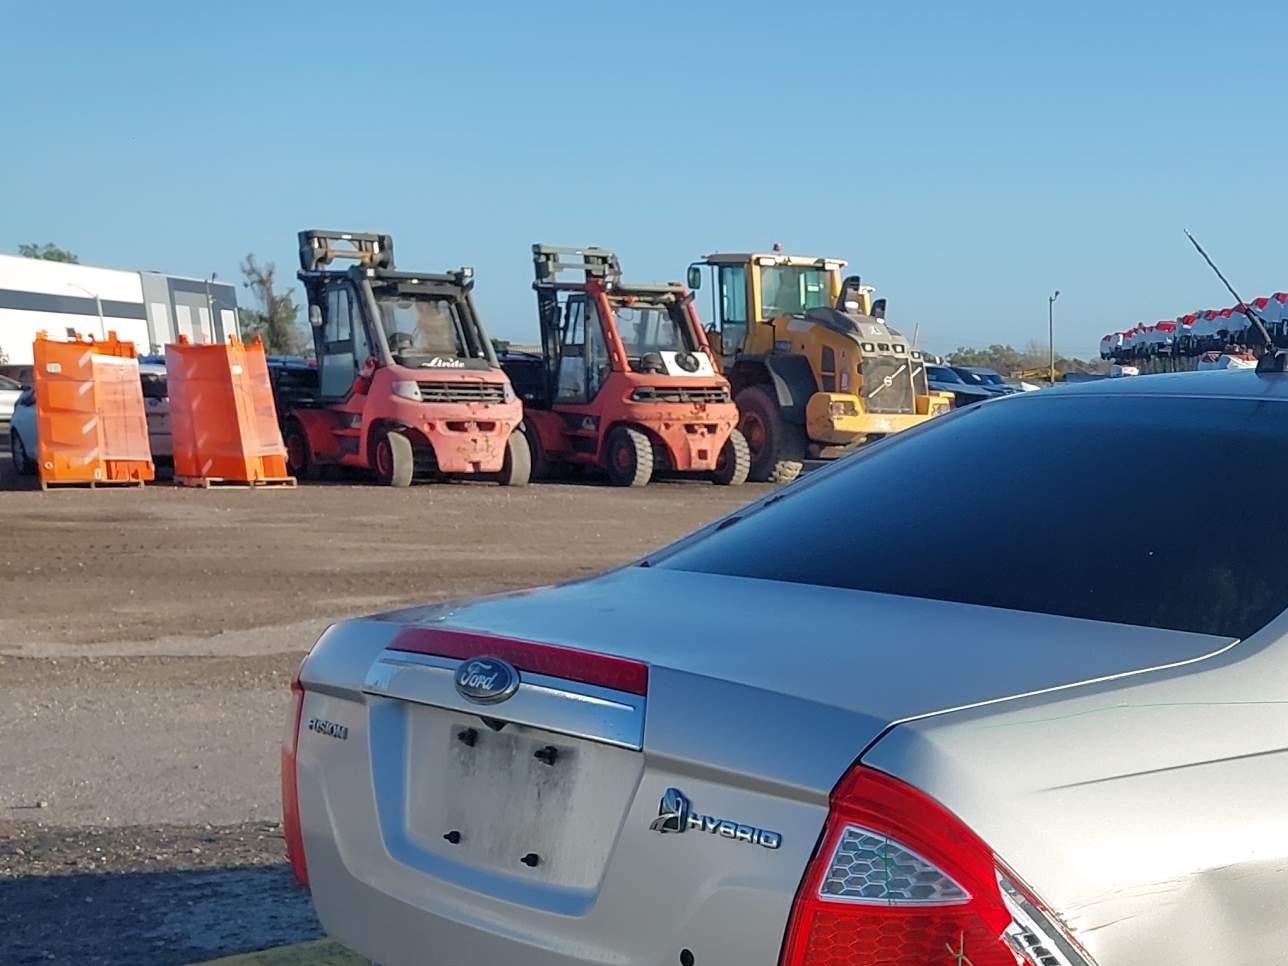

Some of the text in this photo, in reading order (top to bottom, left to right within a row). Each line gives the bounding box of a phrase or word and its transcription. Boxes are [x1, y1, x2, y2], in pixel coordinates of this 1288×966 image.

[421, 356, 465, 368] Linde
[460, 661, 499, 690] Ford
[308, 719, 349, 740] FUSION
[687, 812, 783, 850] HYBRID
